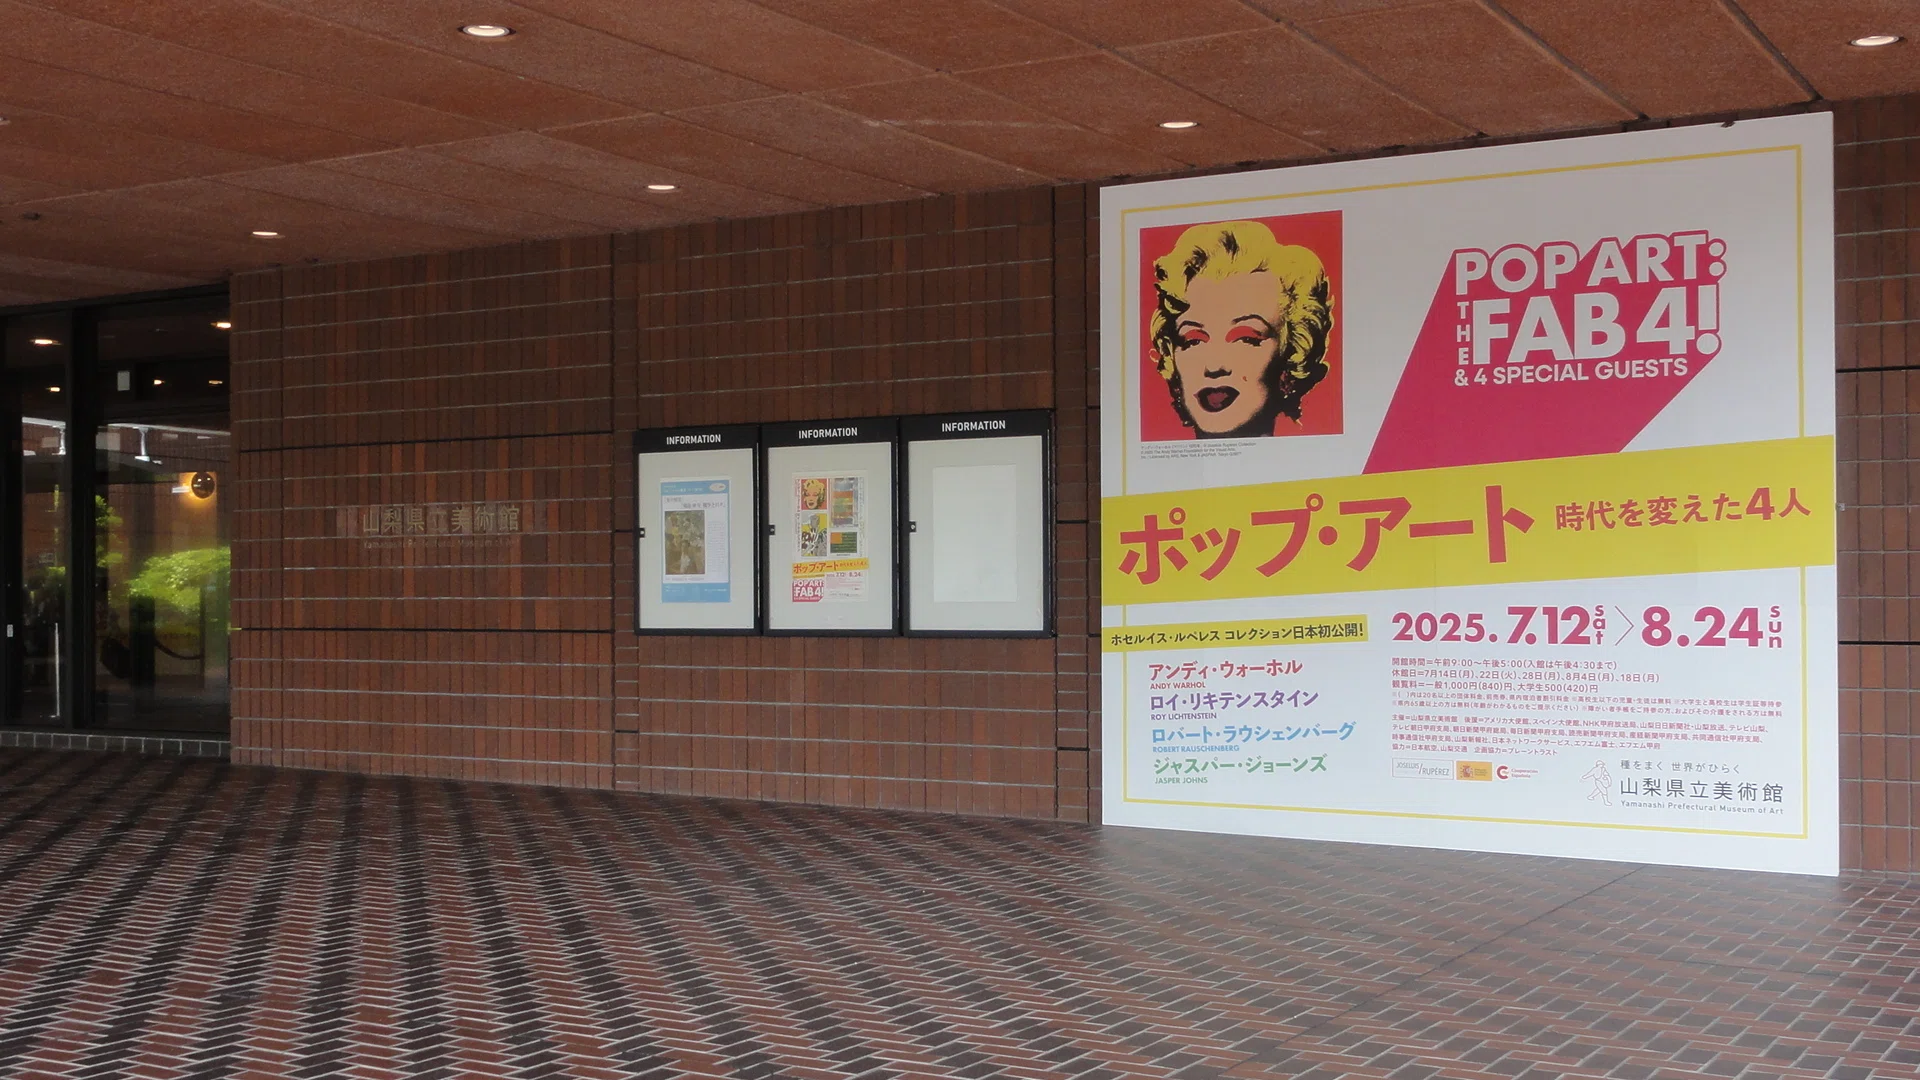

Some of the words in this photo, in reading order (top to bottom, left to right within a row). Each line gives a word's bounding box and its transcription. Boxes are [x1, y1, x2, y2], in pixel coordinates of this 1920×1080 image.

[1456, 245, 1578, 295] POP
[1587, 234, 1724, 287] ART:
[1457, 301, 1471, 366] THE
[1473, 292, 1626, 364] FAB
[1636, 284, 1720, 355] 4!
[1454, 370, 1469, 386] &
[1474, 367, 1488, 384] 4
[1493, 363, 1589, 384] SPECIAL
[1595, 358, 1688, 379] GUESTS
[798, 427, 858, 439] INFORMATION
[942, 420, 1006, 432] INFORMATION
[666, 434, 721, 445] INFORMATION
[363, 505, 520, 533] 山梨県立美術館
[1118, 485, 1535, 585] ポップ・アート
[1555, 487, 1811, 531] 時代を変えた4人
[1111, 630, 1220, 646] ホセルイス・ルペレス
[1225, 623, 1364, 641] コレクション日本初公開!
[1391, 611, 1498, 643] 2025.
[1507, 605, 1591, 645] 7.12
[1641, 605, 1764, 647] 8.24
[1149, 659, 1303, 681] アンディ・ウォーホル
[1150, 682, 1171, 690] ANDY
[1173, 681, 1206, 689] WARHOL
[1151, 690, 1319, 711] ロイ・リキテンスタイン
[1151, 713, 1166, 721] ROY
[1168, 712, 1217, 720] LICHTENSTEIN
[1152, 721, 1357, 743] ロバート・ラウシェンバーグ
[1154, 753, 1328, 775] ジャスパー・ジョーンズ
[1620, 760, 1664, 771] 種をまく
[1671, 762, 1740, 775] 世界がひらく
[1182, 776, 1208, 784] JOHNS
[1620, 777, 1784, 803] 山梨県立美術館
[1621, 800, 1665, 809] Yamanashi
[1668, 802, 1716, 811] Prefectural
[1720, 805, 1755, 813] Museum
[1758, 806, 1767, 814] of
[1769, 807, 1784, 815] Art
